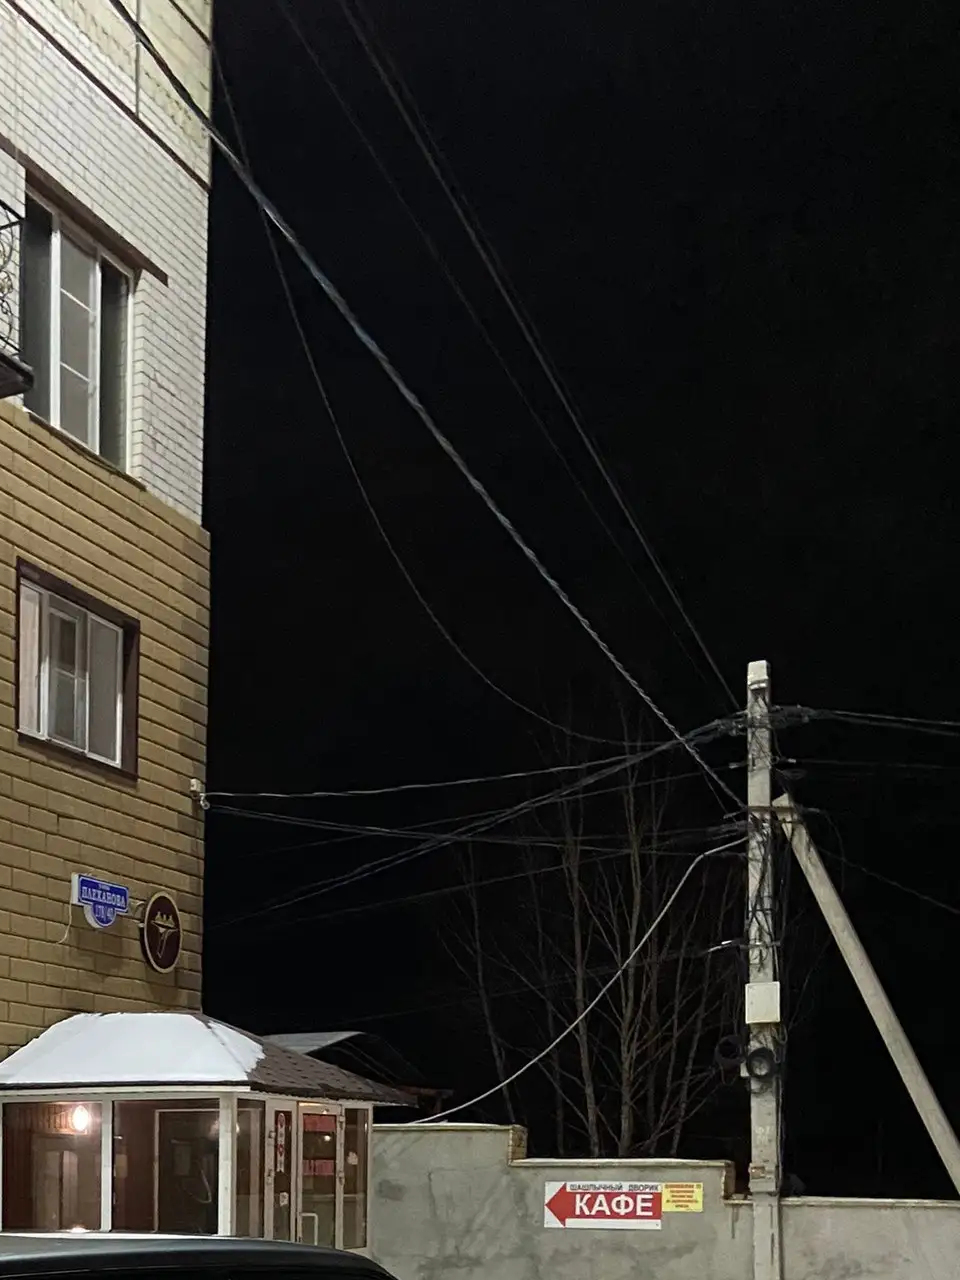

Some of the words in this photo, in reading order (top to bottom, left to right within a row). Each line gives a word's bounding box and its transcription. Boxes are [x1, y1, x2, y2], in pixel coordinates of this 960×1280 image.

[569, 1183, 624, 1192] ШАШЛЫЧНЫЙ
[628, 1184, 659, 1192] ДВОРИК
[574, 1193, 654, 1216] КАФЕ
